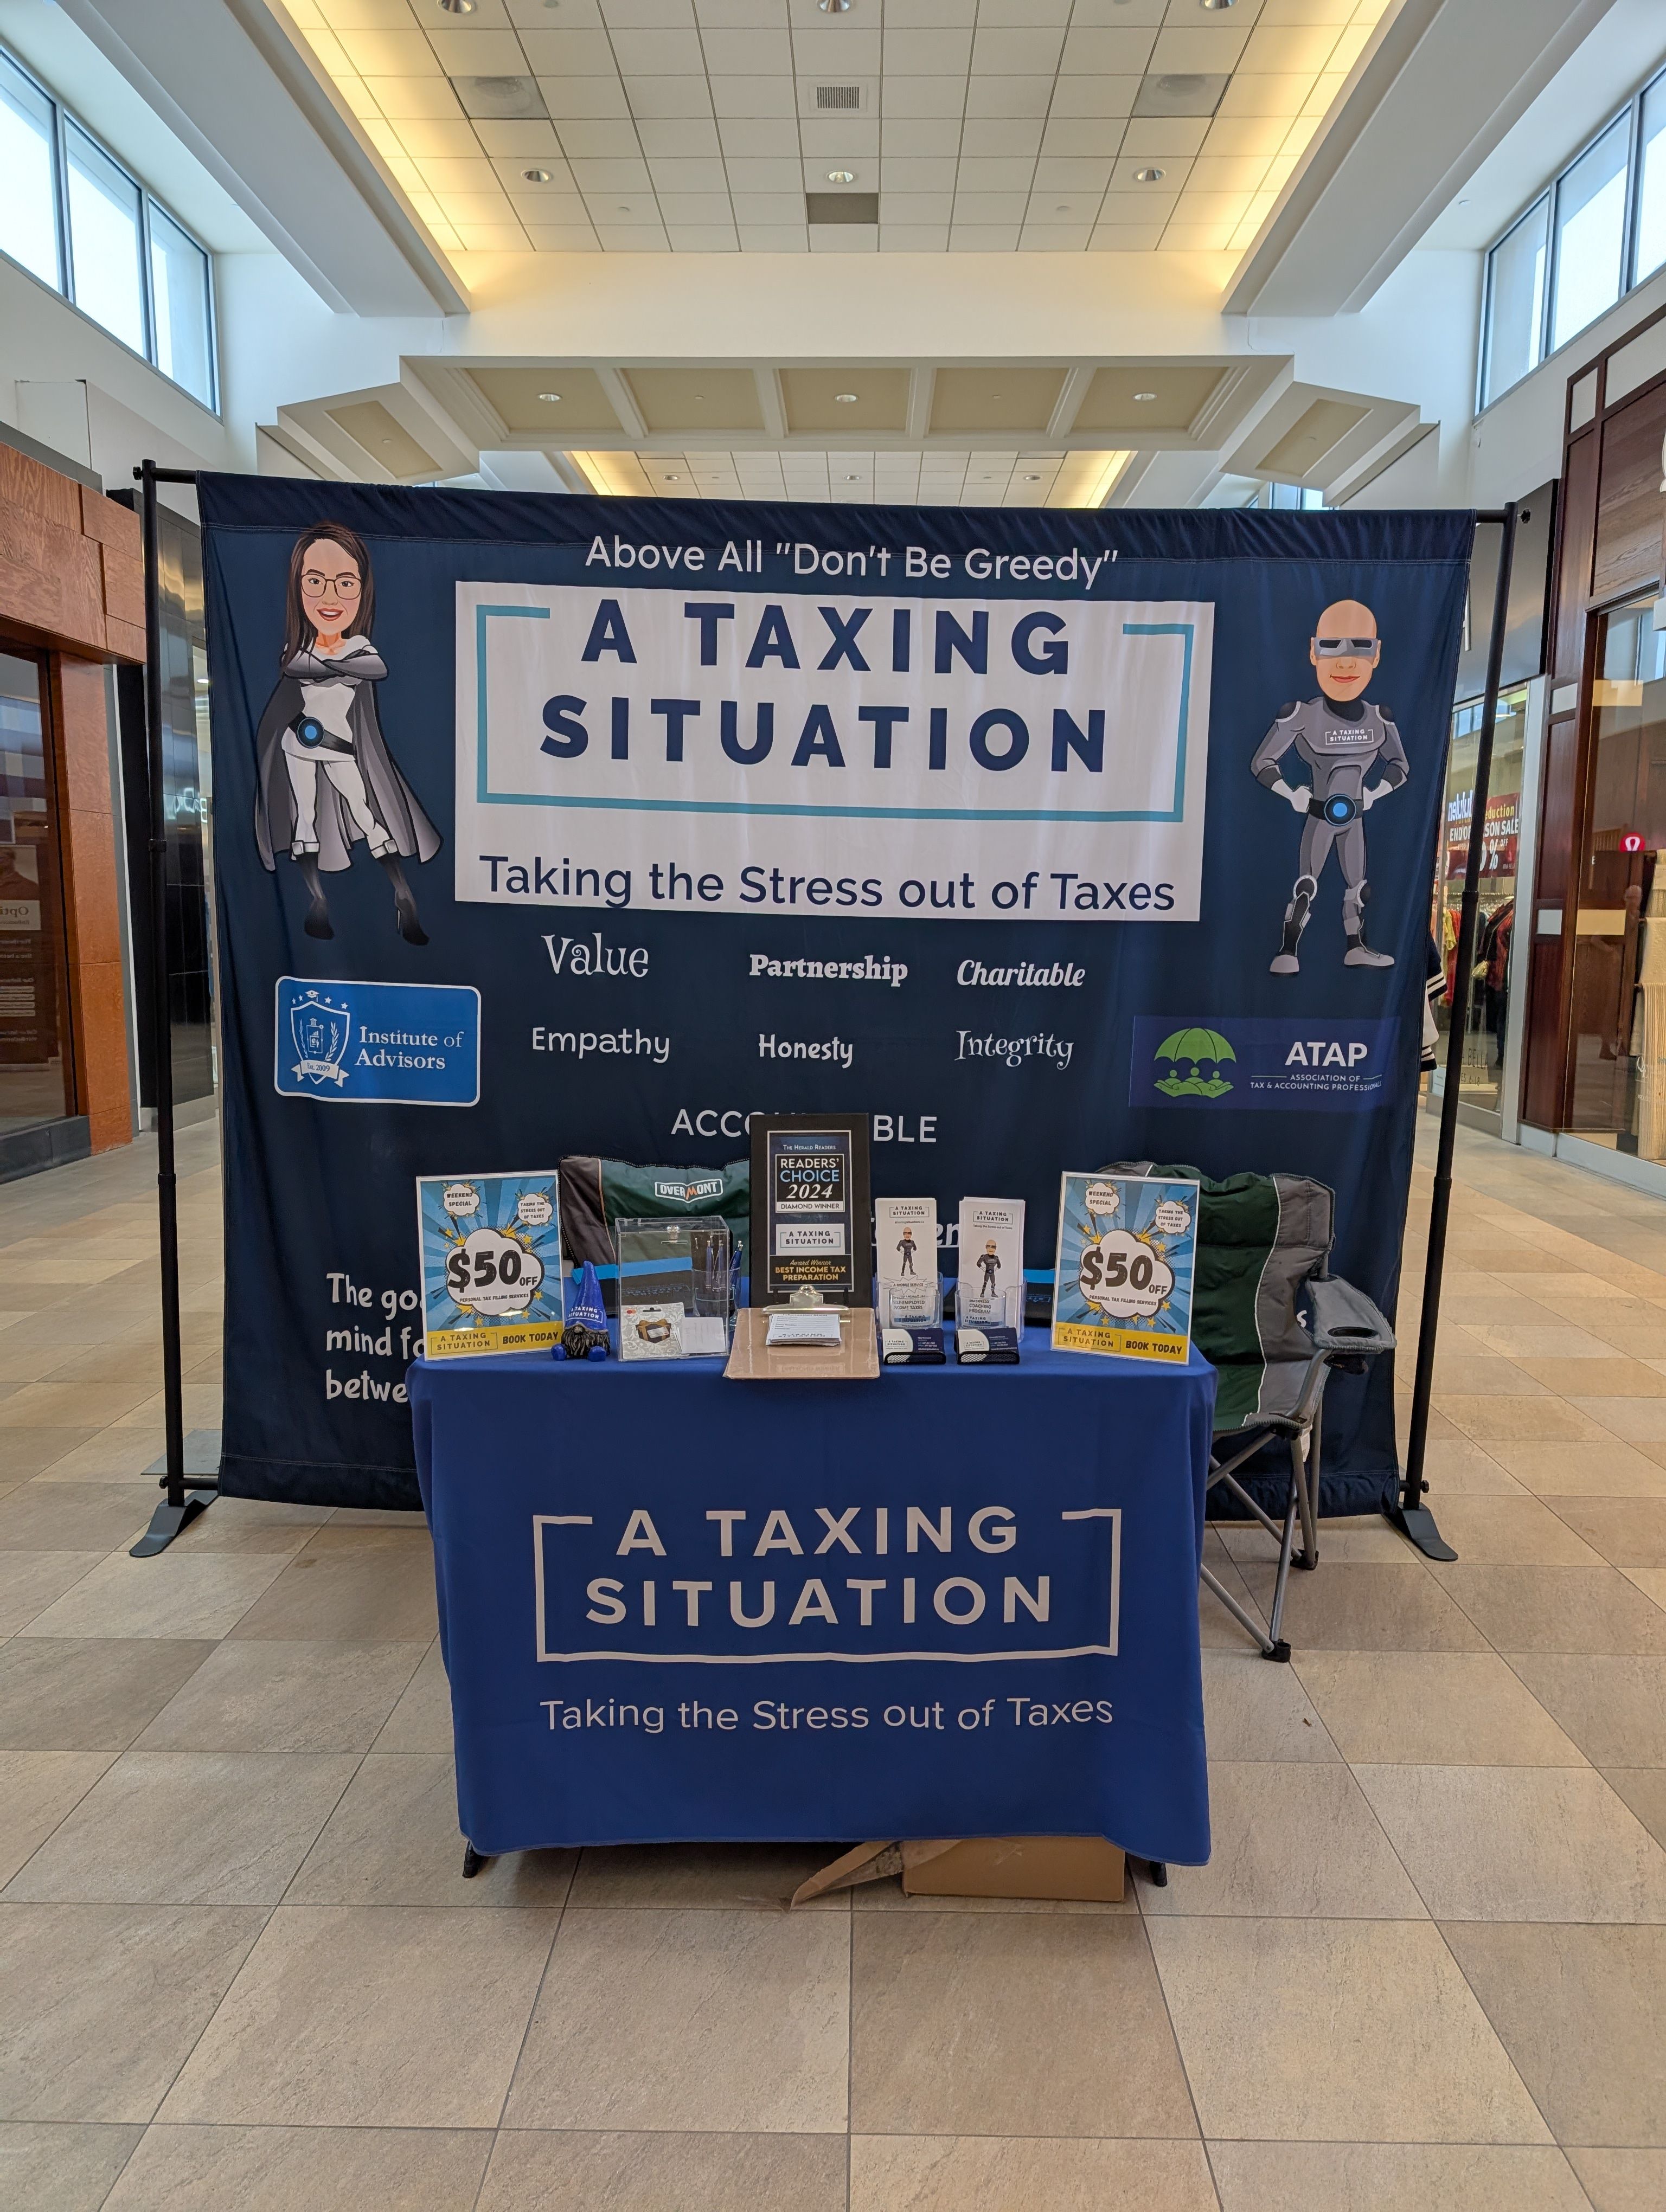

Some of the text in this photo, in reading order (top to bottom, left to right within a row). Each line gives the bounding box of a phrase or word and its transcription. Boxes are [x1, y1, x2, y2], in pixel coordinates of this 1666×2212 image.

[586, 536, 1119, 590] Above All "Don't Be Greedy"
[581, 599, 1069, 675] A TAXING
[540, 695, 1106, 773] SITUATION
[1450, 827, 1463, 842] END
[1483, 821, 1500, 838] SON
[1501, 818, 1519, 836] SALE
[1500, 838, 1509, 847] OFF
[479, 855, 1175, 912] Taking the Stress out of Taxes
[541, 933, 650, 978] Value
[749, 954, 908, 987] Partnership
[957, 960, 1086, 987] Charitable
[360, 1026, 464, 1047] Institute of
[532, 1027, 670, 1064] Empathy
[354, 1049, 445, 1070] Advisors
[759, 1034, 853, 1068] Honesty
[954, 1030, 1074, 1070] Integrity
[1285, 1041, 1368, 1067] ATAP
[307, 1063, 330, 1072] Est. 2009
[1290, 1074, 1346, 1082] ASSOCIATION
[670, 1109, 938, 1143] ACCBLE
[780, 1158, 840, 1168] READERS'
[780, 1169, 840, 1182] CHOICE
[660, 1182, 717, 1200] OVERMONT
[786, 1184, 833, 1199] 2024
[447, 1249, 522, 1293] $50
[1080, 1246, 1153, 1290] $50
[326, 1272, 373, 1308] The
[519, 1276, 538, 1287] OFF
[1149, 1284, 1168, 1295] OFF
[326, 1325, 393, 1356] mind
[437, 1340, 490, 1351] SITUATION
[450, 1332, 486, 1341] TAXING
[502, 1332, 559, 1345] BOOK TODAY
[1063, 1336, 1113, 1347] SITUATION
[1077, 1329, 1110, 1339] TAXING
[1125, 1340, 1182, 1354] BOOK TODAY
[616, 1506, 1017, 1557] A TAXING
[585, 1575, 1050, 1628] SITUATION
[540, 1697, 1113, 1733] Taking the Stress out of Taxes
